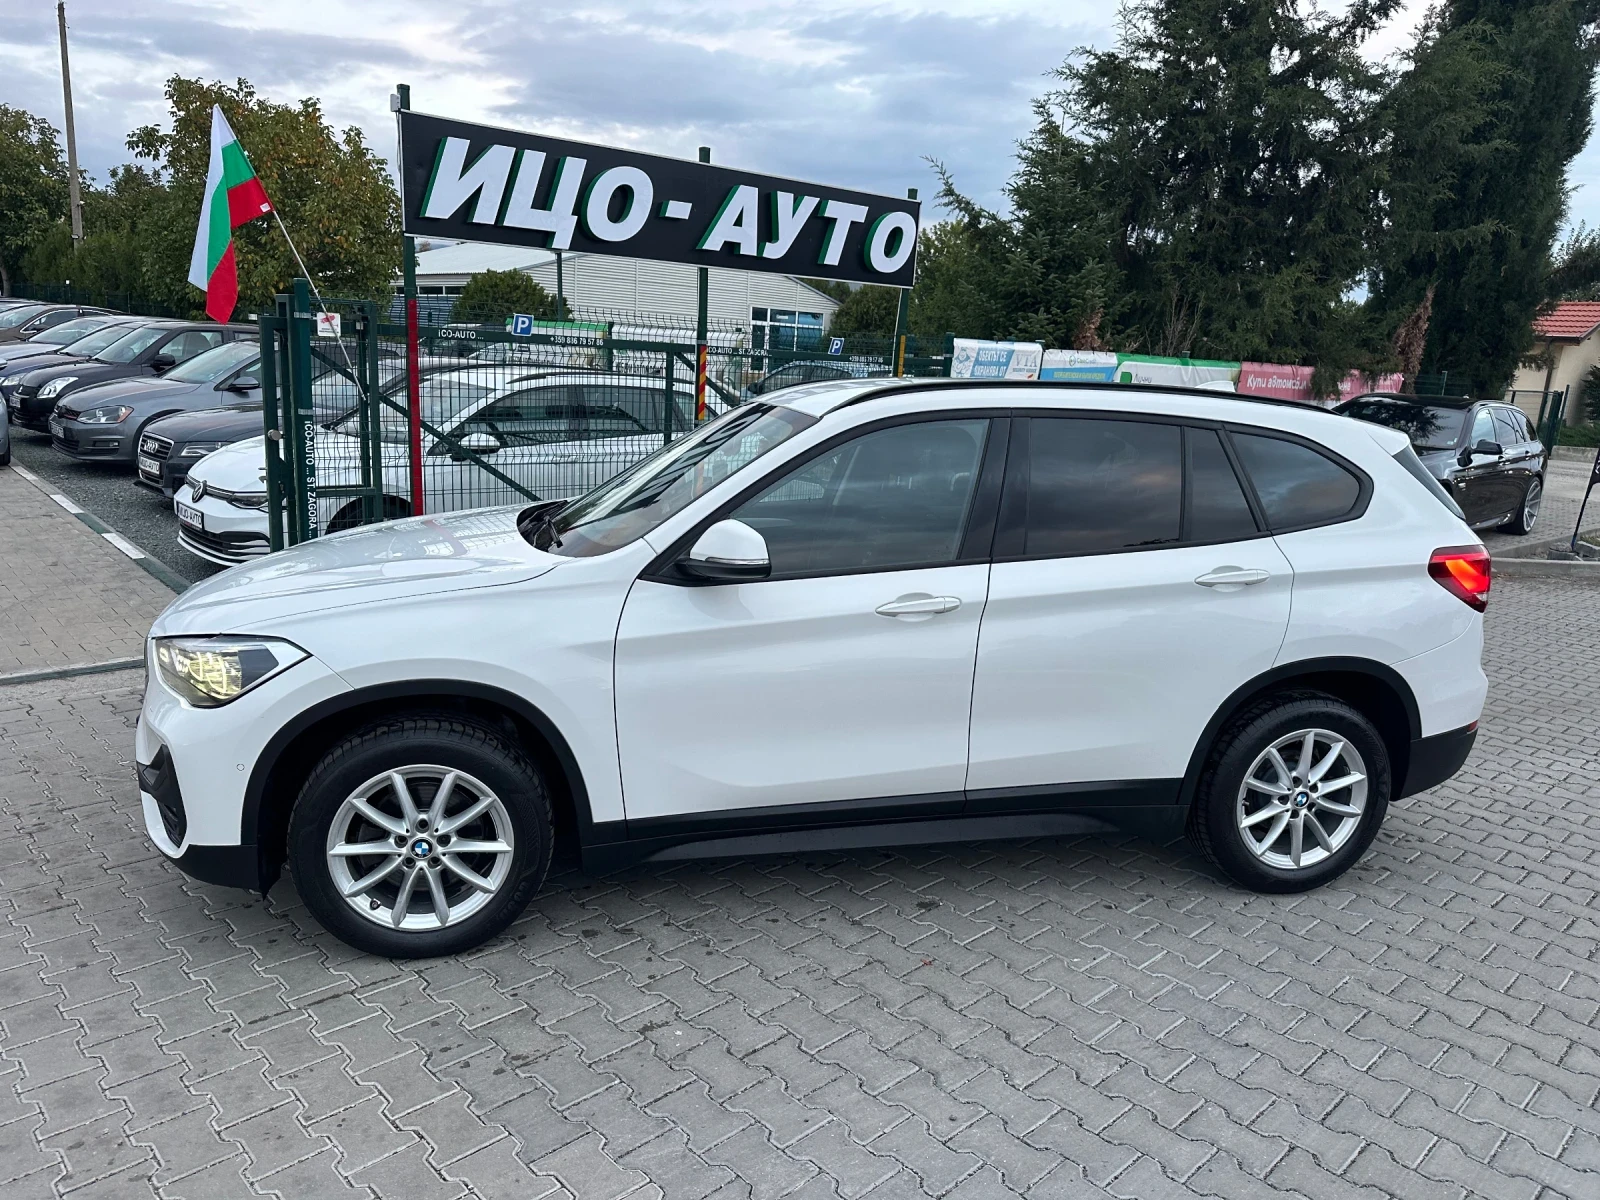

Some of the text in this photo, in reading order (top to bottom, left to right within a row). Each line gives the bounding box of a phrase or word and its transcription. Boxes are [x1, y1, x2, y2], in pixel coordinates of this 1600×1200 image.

[419, 136, 917, 273] ИЦО-АУТО
[516, 317, 529, 333] P
[579, 337, 587, 346] 79
[587, 338, 595, 346] 57
[832, 340, 841, 352] P
[1015, 353, 1038, 367] VTA
[1246, 374, 1266, 391] Купи
[306, 476, 315, 490] ST.
[307, 491, 317, 530] ZAGORA
